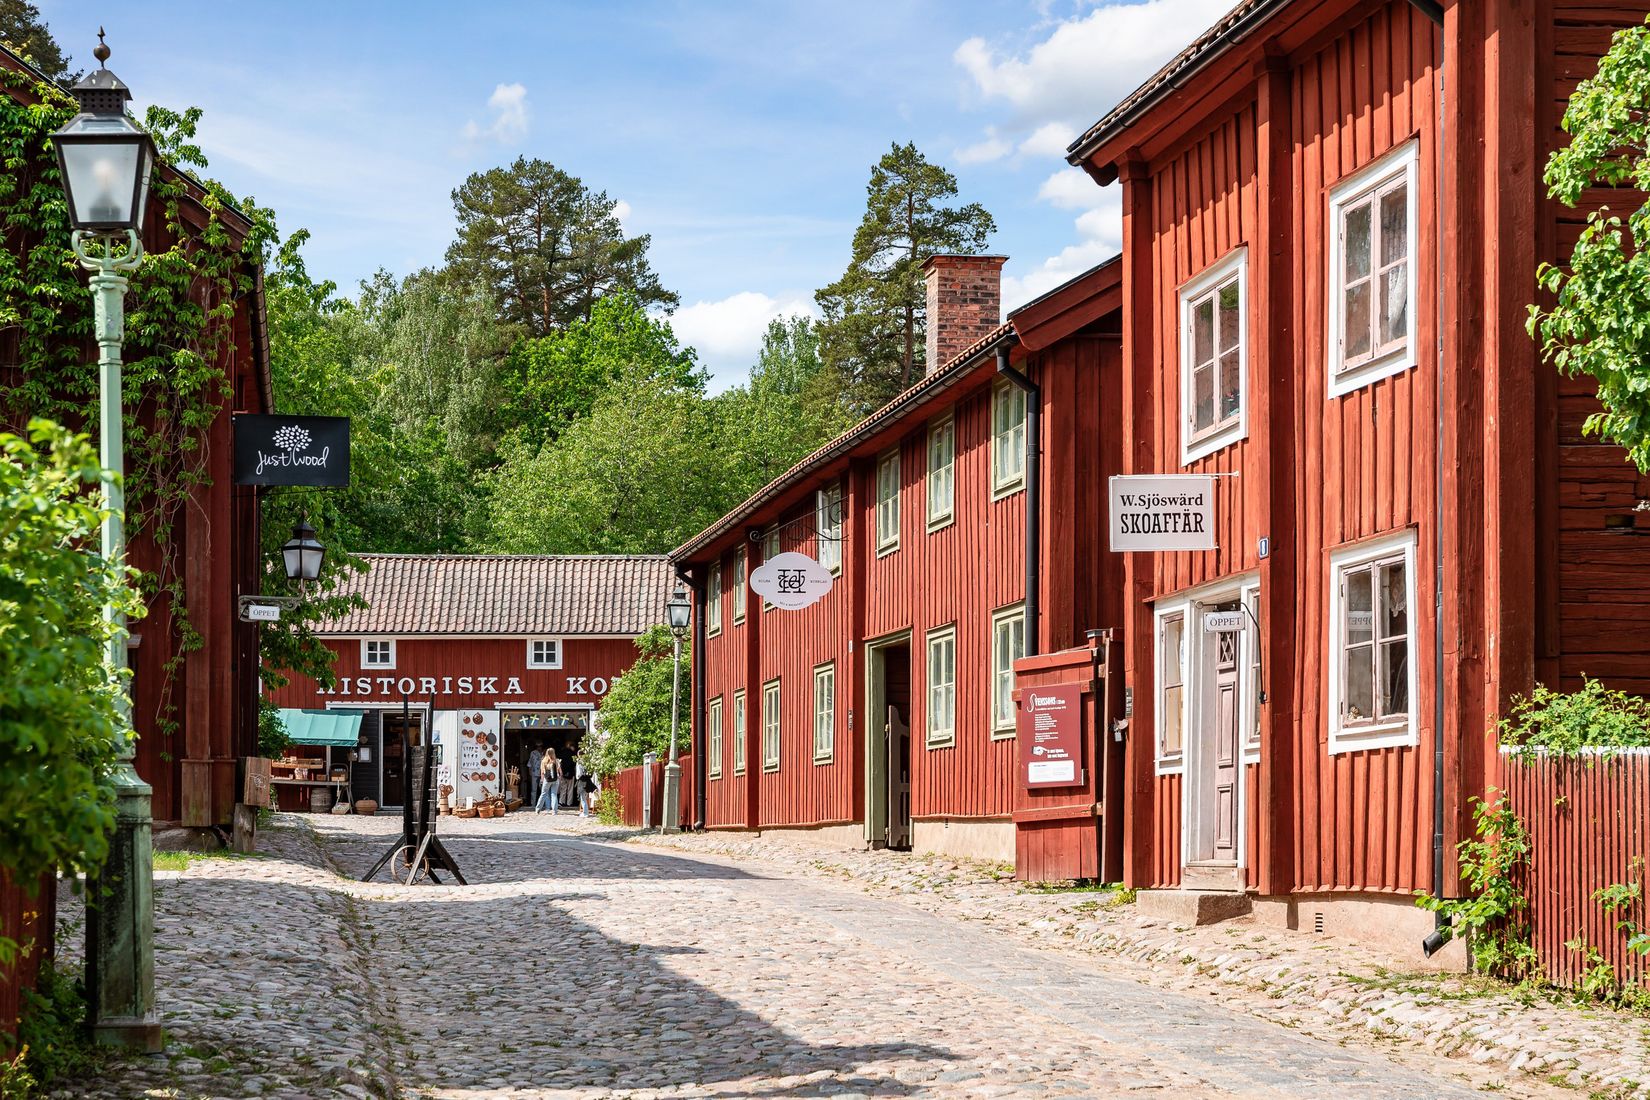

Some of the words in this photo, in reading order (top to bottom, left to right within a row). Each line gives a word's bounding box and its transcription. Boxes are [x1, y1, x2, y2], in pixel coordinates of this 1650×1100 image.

[1120, 493, 1203, 509] W.Sjöswärd
[1120, 509, 1204, 534] SKOAFFÄR
[252, 609, 276, 617] ÖPPET
[1210, 617, 1241, 627] ÖPPET
